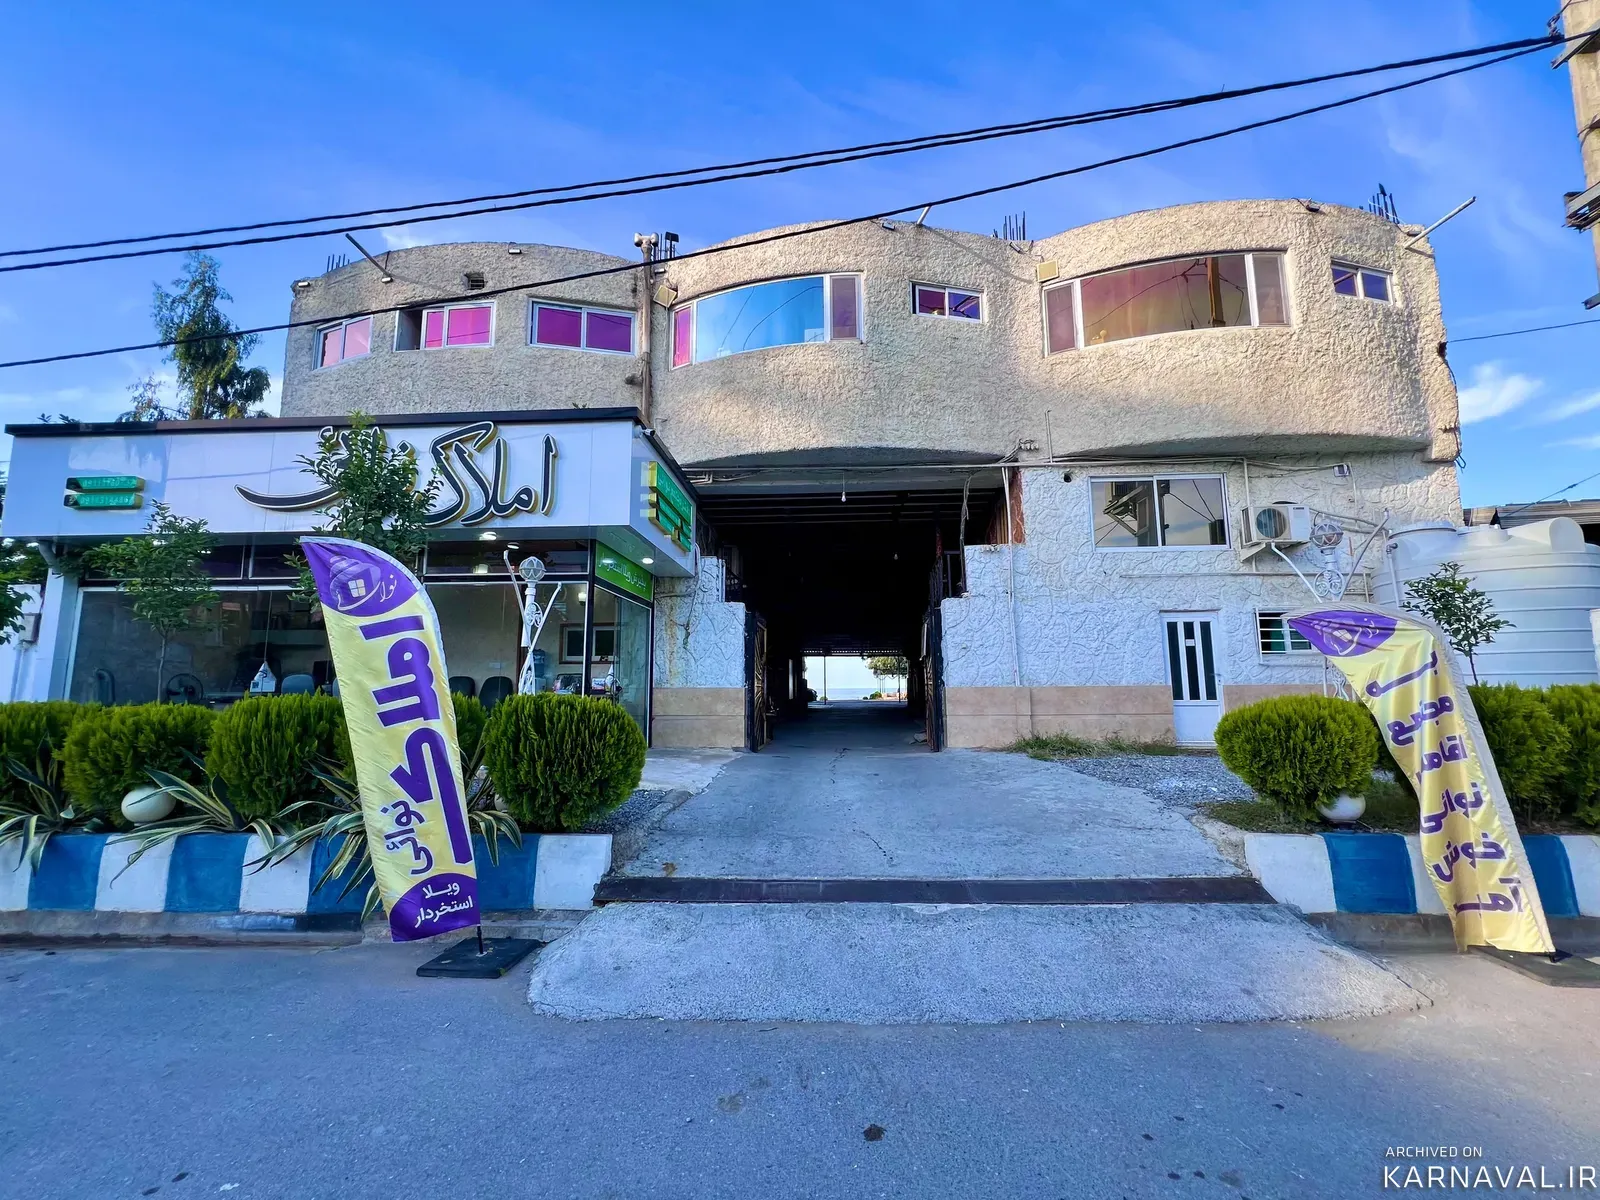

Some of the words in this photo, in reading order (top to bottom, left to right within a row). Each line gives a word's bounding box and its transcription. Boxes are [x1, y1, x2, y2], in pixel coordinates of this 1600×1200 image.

[1365, 650, 1439, 698] به
[359, 614, 474, 865] املاک
[1432, 832, 1507, 883] خوش
[414, 895, 474, 928] استخردار
[422, 882, 461, 899] ویلا
